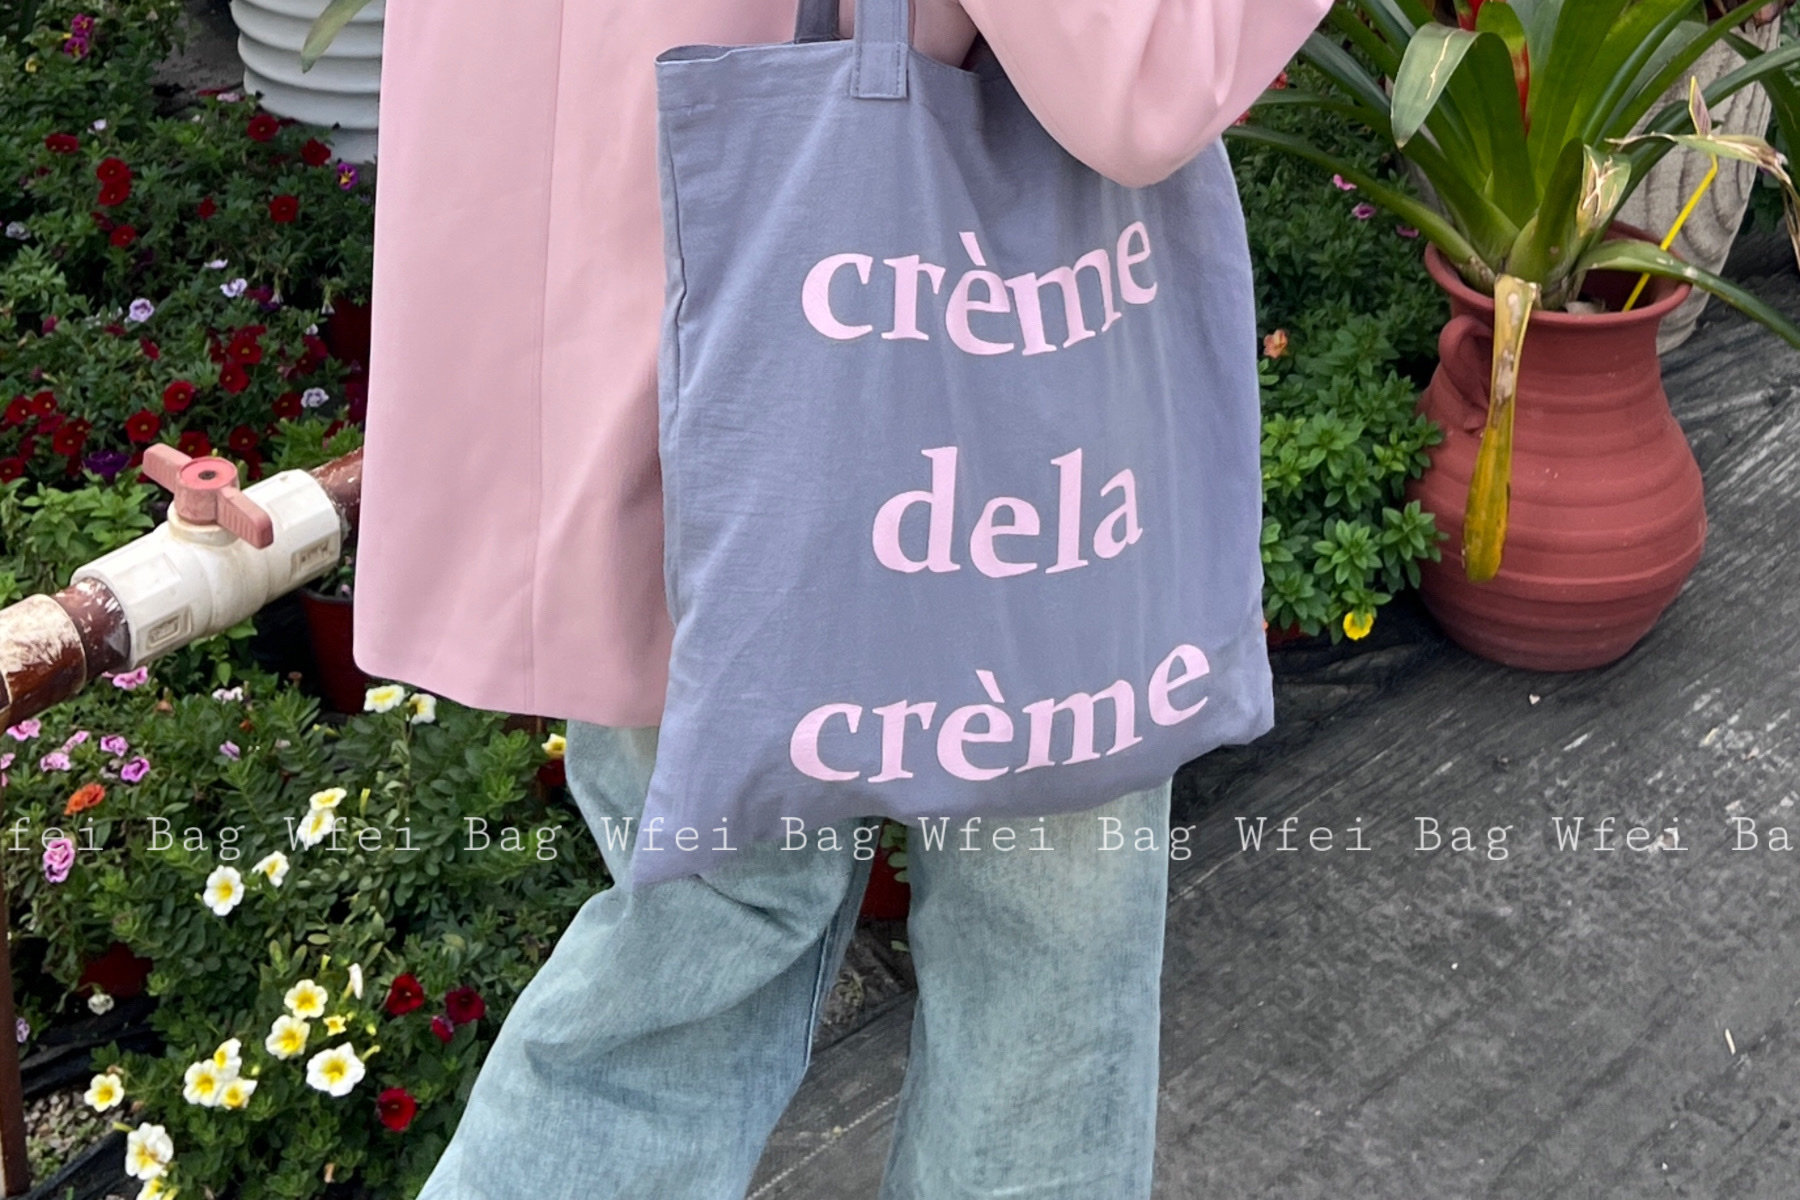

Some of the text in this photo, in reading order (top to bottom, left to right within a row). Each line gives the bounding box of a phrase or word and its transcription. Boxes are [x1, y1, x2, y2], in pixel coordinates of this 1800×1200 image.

[801, 220, 1157, 356] crème
[872, 446, 1143, 578] dela
[789, 644, 1210, 783] crème
